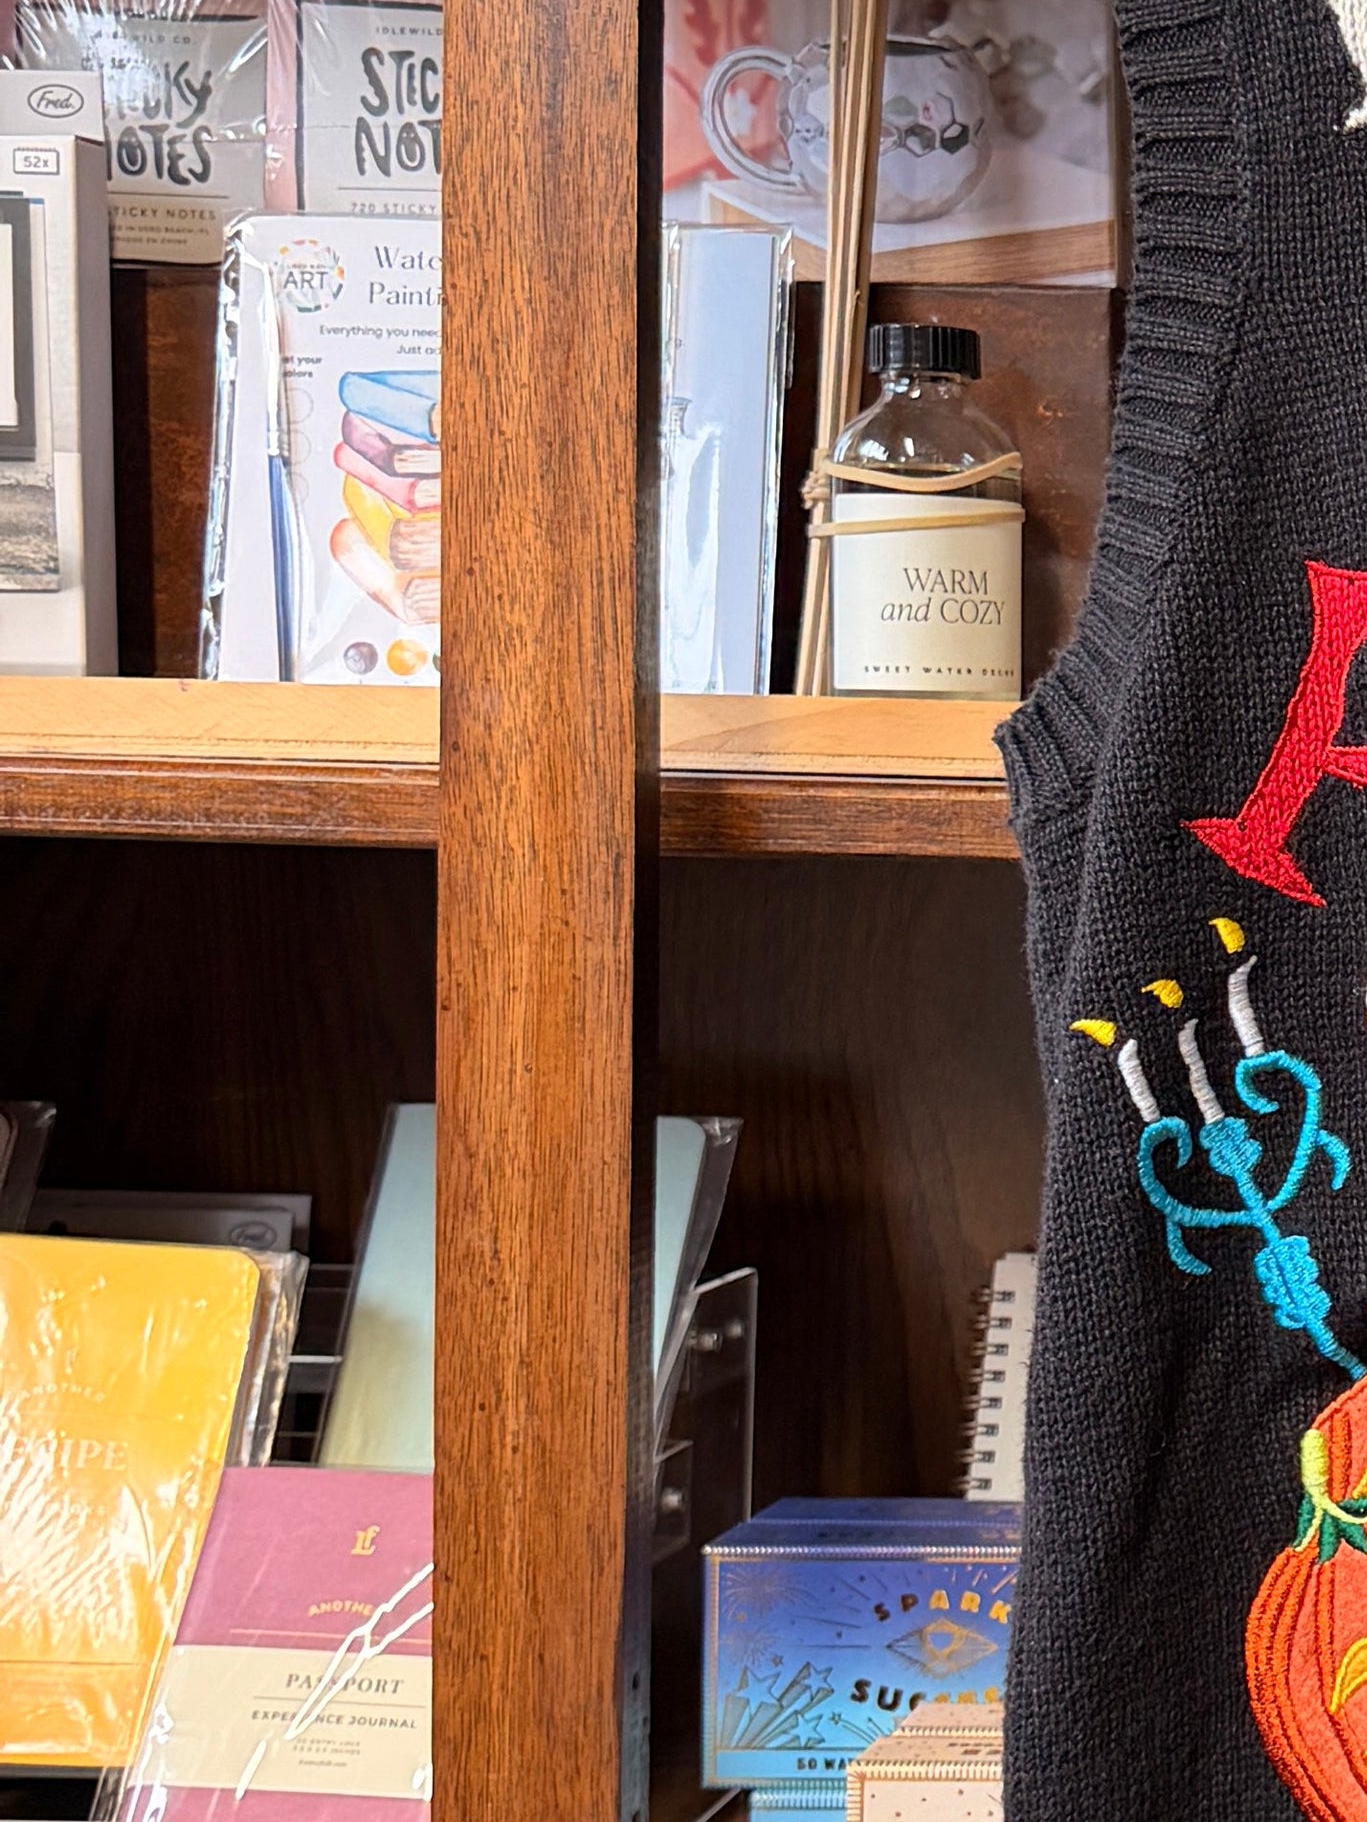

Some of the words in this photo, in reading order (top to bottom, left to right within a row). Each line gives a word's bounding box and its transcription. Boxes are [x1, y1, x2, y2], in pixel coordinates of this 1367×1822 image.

[23, 154, 49, 169] 52x
[105, 124, 213, 186] OTES
[167, 209, 216, 220] NOTES
[351, 202, 375, 214] 720
[384, 203, 437, 214] STICKY
[283, 271, 328, 289] ART
[319, 325, 383, 339] Everything
[386, 327, 409, 338] you
[396, 345, 422, 355] Just
[902, 567, 988, 595] WARM
[881, 597, 932, 622] and
[940, 598, 1005, 625] COZY
[864, 665, 911, 674] SWEET
[923, 666, 973, 676] WATER
[348, 1715, 418, 1730] JOURNAL
